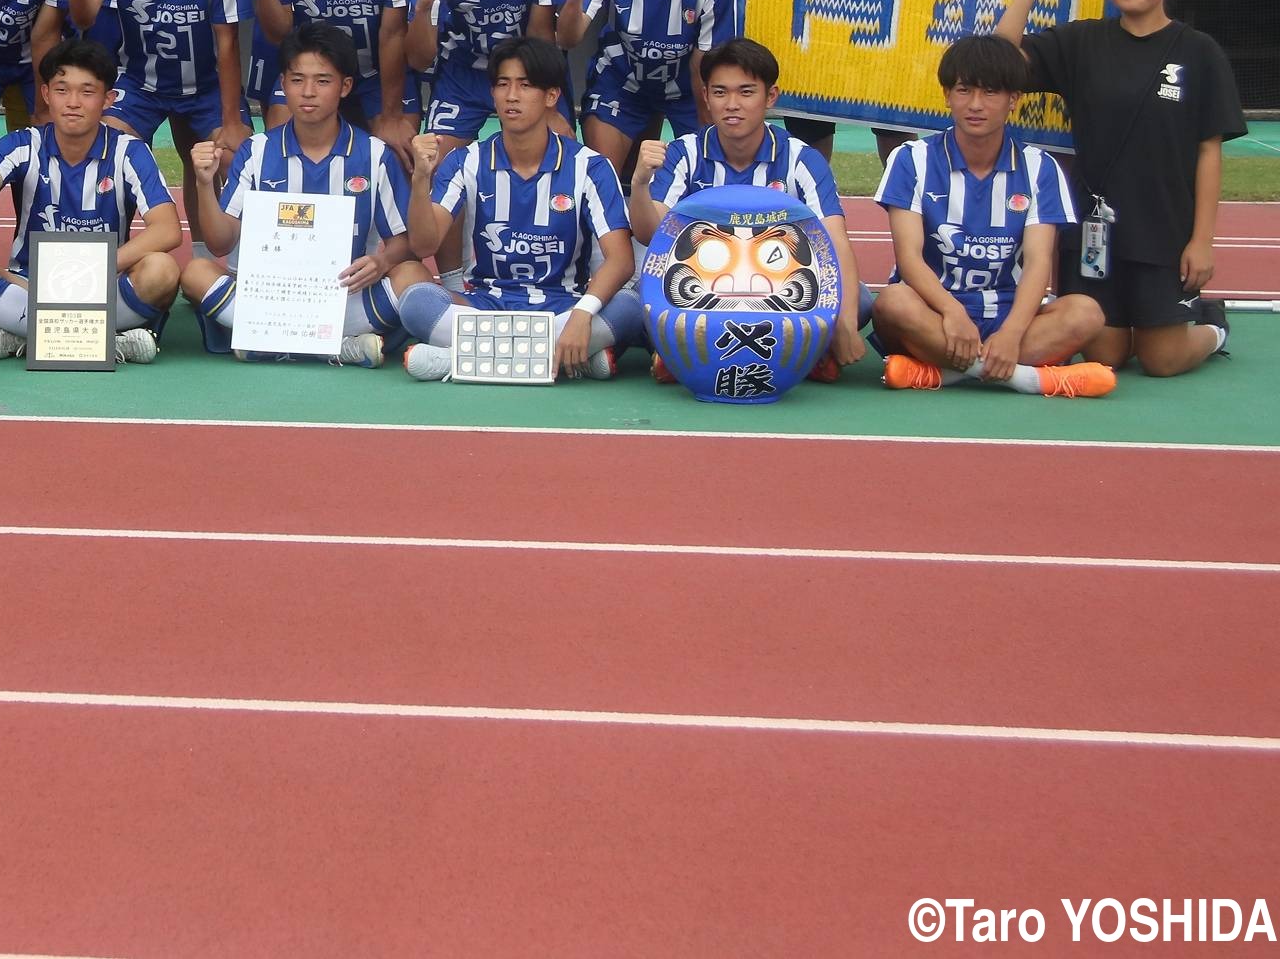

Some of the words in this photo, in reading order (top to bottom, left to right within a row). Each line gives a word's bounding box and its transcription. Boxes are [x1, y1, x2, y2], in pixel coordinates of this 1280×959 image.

[157, 3, 200, 15] KAGOSHIMA
[324, 4, 380, 21] JOSEI
[326, 0, 373, 11] KAGOSHIMA
[150, 11, 205, 28] JOSEI
[156, 30, 180, 60] 2
[1157, 88, 1180, 99] JOSEI
[427, 101, 460, 130] 12
[60, 214, 105, 226] KAGOSHIMA
[728, 210, 789, 225] 鹿児島城西
[511, 230, 559, 243] KAGOSHIMA
[964, 235, 1015, 246] KAGOSHIMA
[503, 238, 565, 255] JOSEI
[714, 319, 778, 398] 必勝
